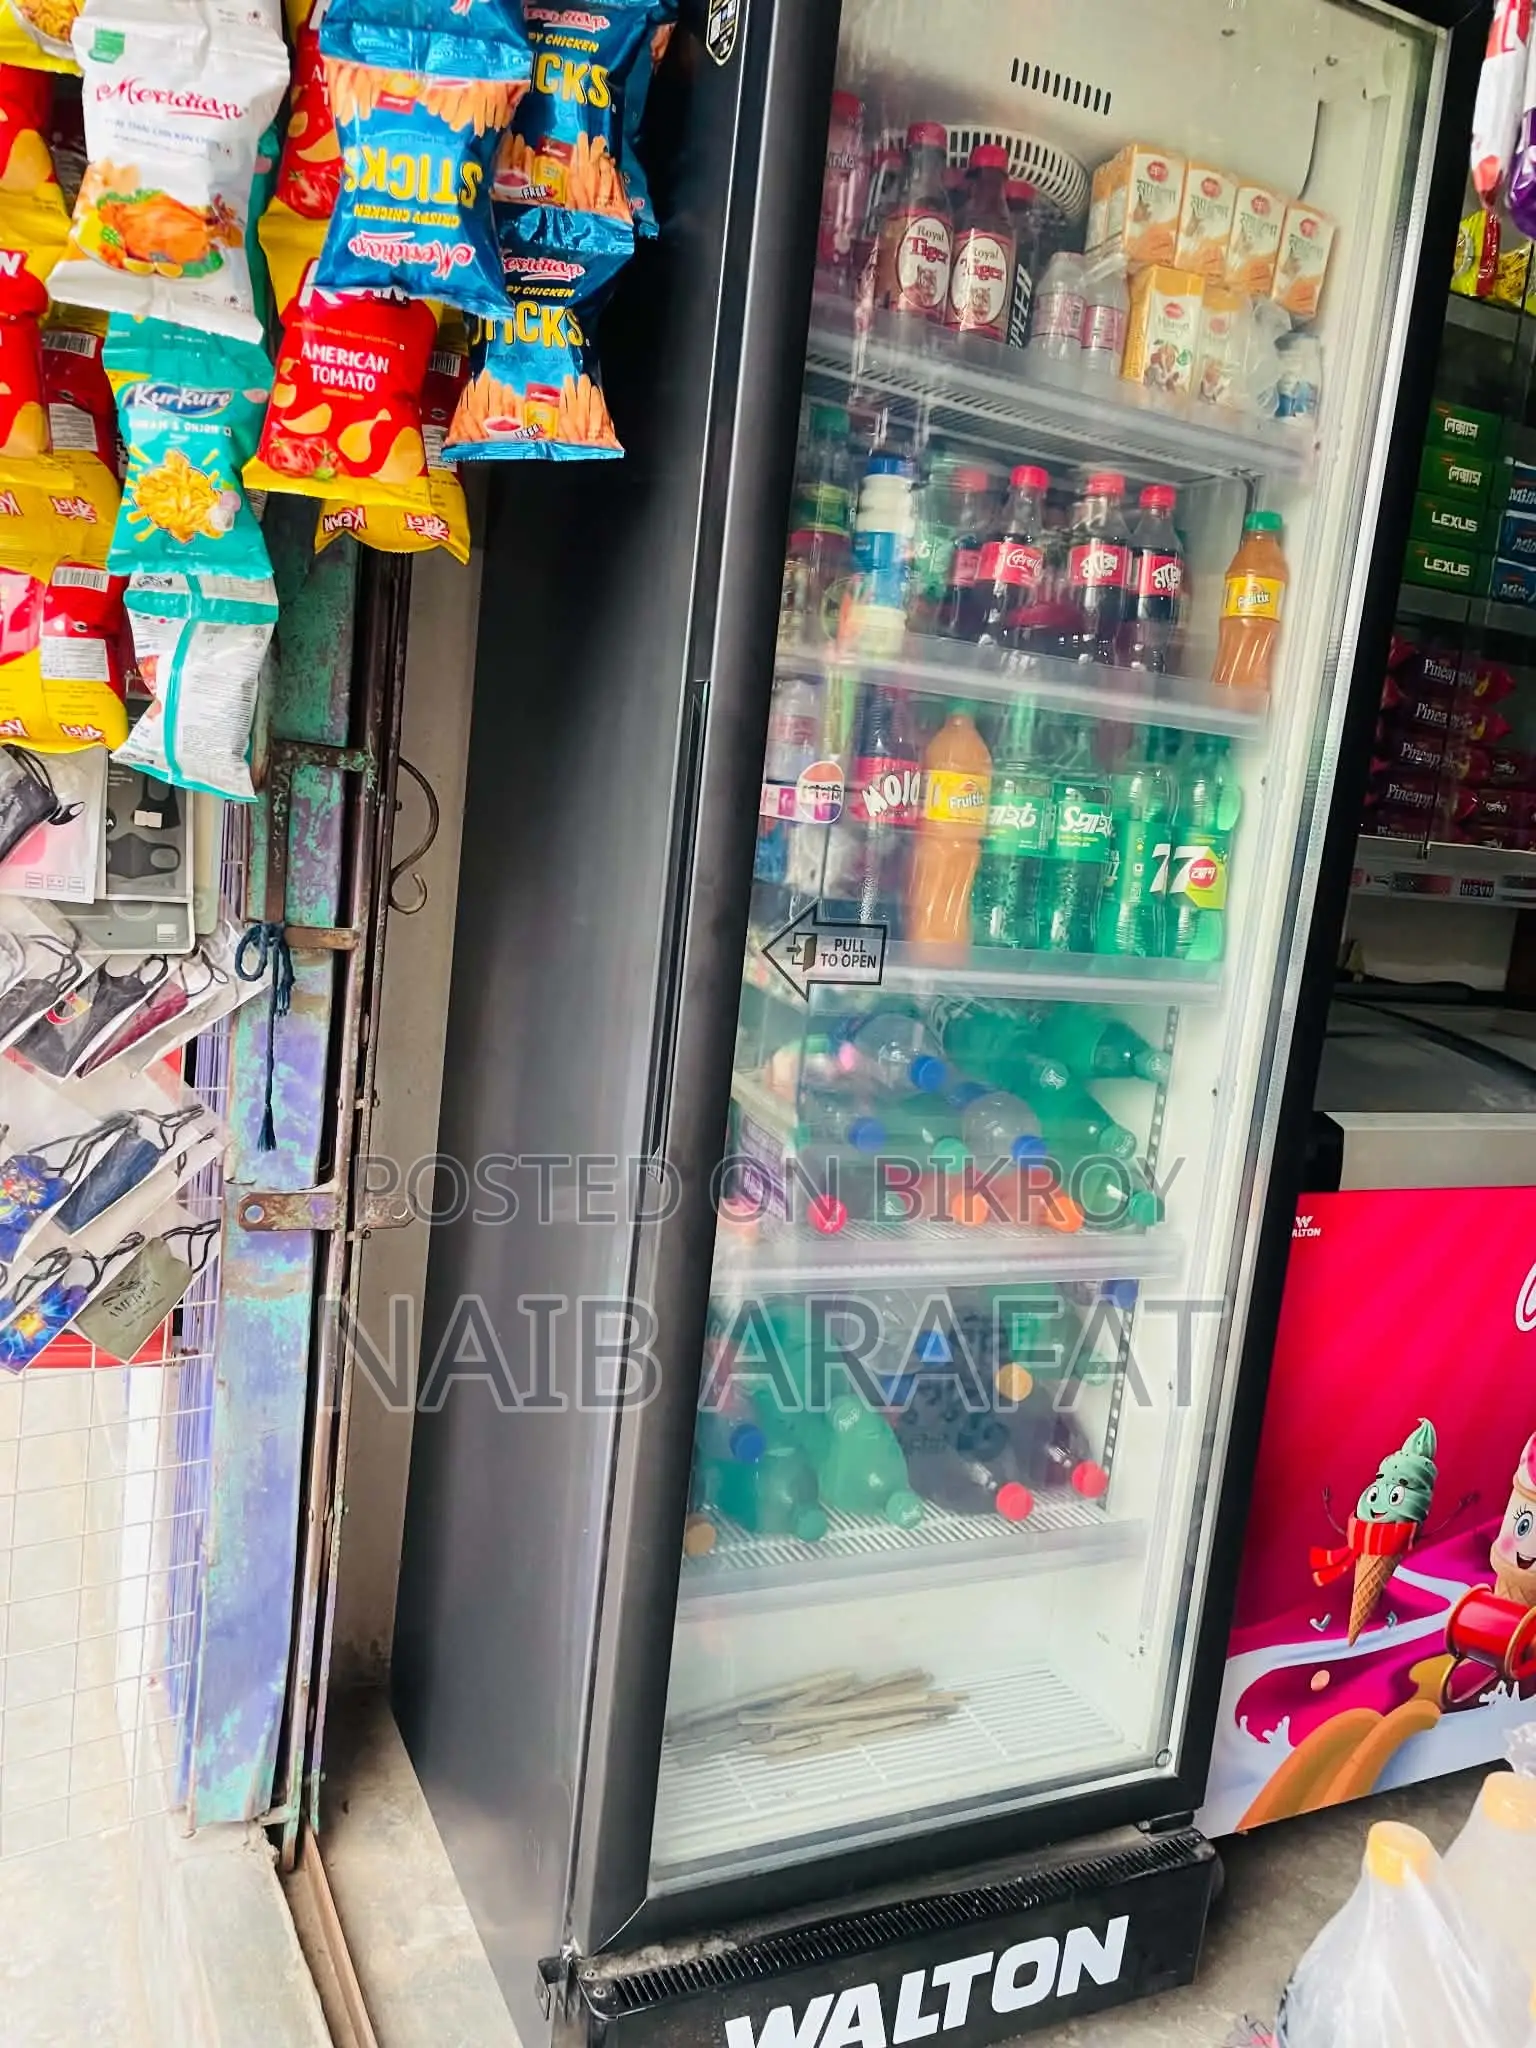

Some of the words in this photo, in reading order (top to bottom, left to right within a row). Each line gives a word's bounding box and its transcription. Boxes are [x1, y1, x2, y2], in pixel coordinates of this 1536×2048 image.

[96, 76, 244, 120] Meridian
[343, 144, 483, 208] STICKS
[917, 225, 945, 241] Royal
[908, 236, 949, 263] Tiger
[503, 256, 585, 281] eridian
[522, 286, 575, 298] CHICKEN
[301, 341, 389, 374] AMERICAN
[310, 363, 376, 392] TOMATO
[133, 383, 230, 411] Kurkure
[1431, 511, 1479, 532] LEXUS
[1424, 557, 1471, 577] LEXUS
[834, 938, 867, 953] PULL
[820, 953, 838, 967] TO
[841, 954, 877, 969] OPEN
[1291, 1227, 1321, 1238] ALTON
[723, 1914, 1129, 2048] WALTON
